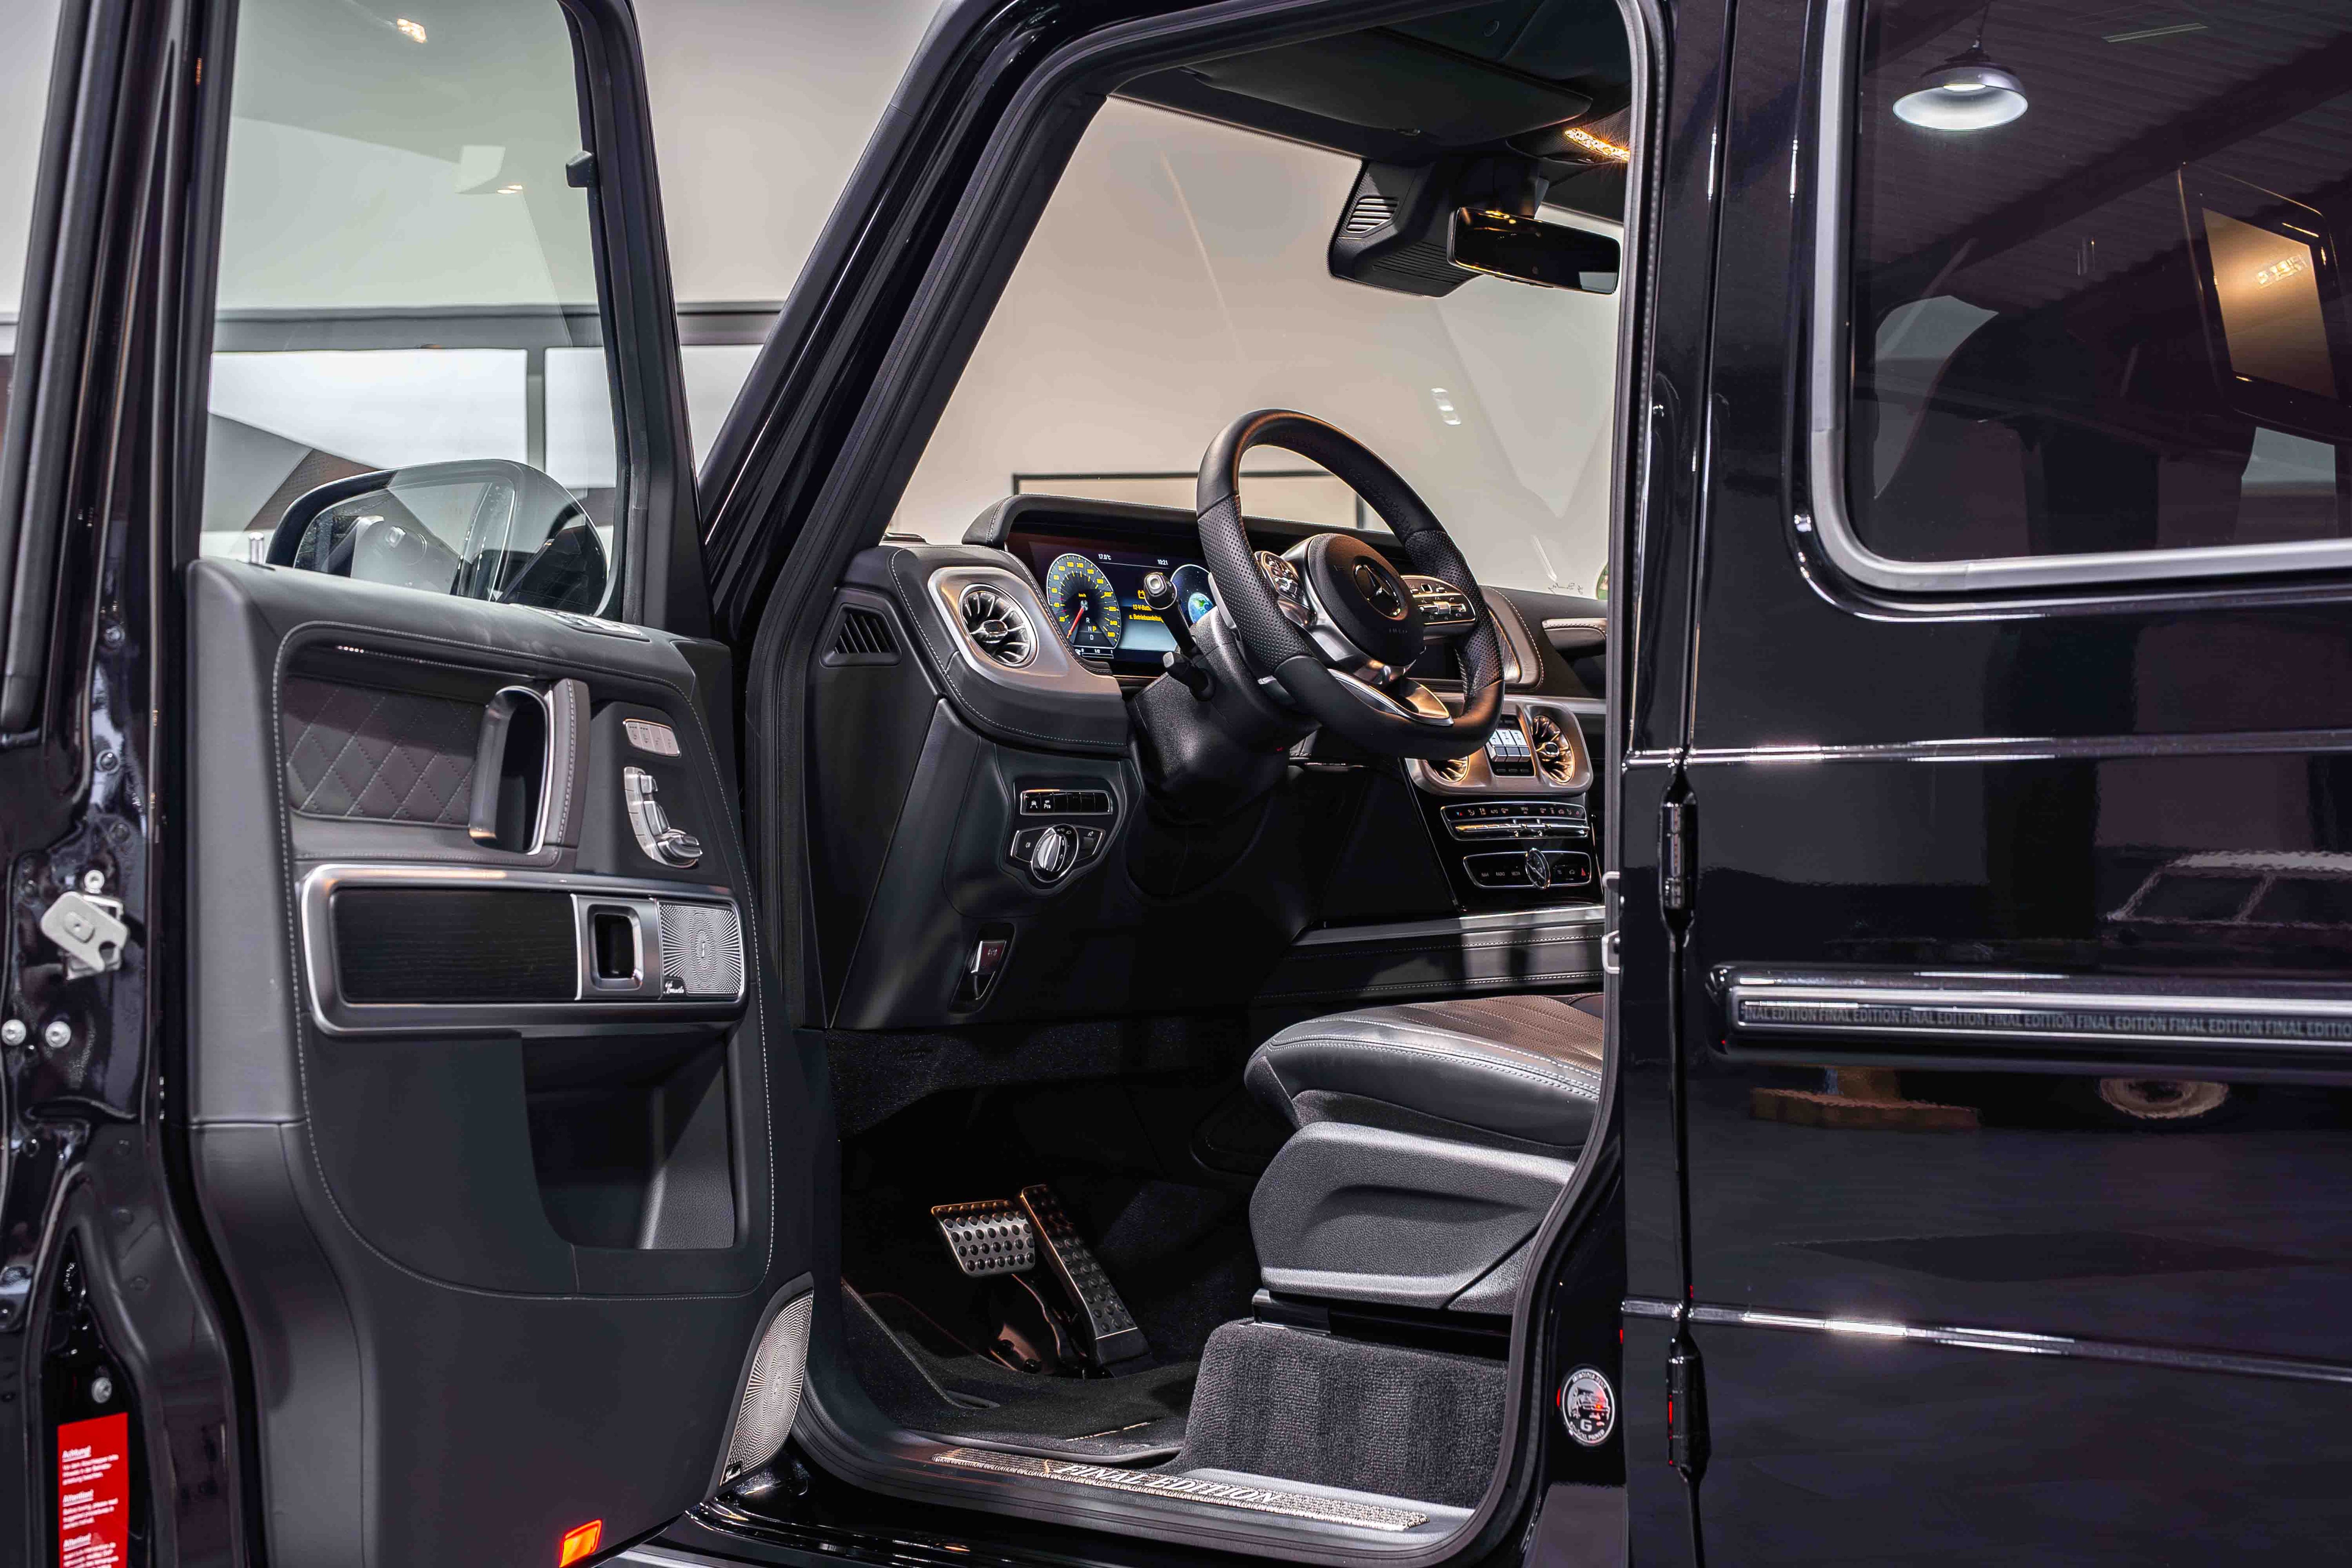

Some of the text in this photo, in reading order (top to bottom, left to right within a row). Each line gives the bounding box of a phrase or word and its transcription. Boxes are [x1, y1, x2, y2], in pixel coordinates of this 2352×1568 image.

[1133, 614, 1164, 623] Betriebsanleitun
[1771, 1007, 1817, 1021] EDITION
[1819, 1008, 1853, 1022] FINAL
[1854, 1009, 1900, 1023] EDITION
[1901, 1010, 1936, 1024] FINAL
[1940, 1011, 1985, 1026] EDITION
[1987, 1013, 2023, 1027] FINAL
[2025, 1013, 2074, 1029] EDITION
[2077, 1015, 2113, 1030] FINAL
[2115, 1016, 2166, 1032] EDITION
[2169, 1018, 2206, 1033] FINAL
[2209, 1018, 2264, 1034] EDITION
[2307, 1021, 2352, 1038] EDITIO
[1580, 1419, 1592, 1432] G
[1054, 1464, 1283, 1503] FINAL EDITION
